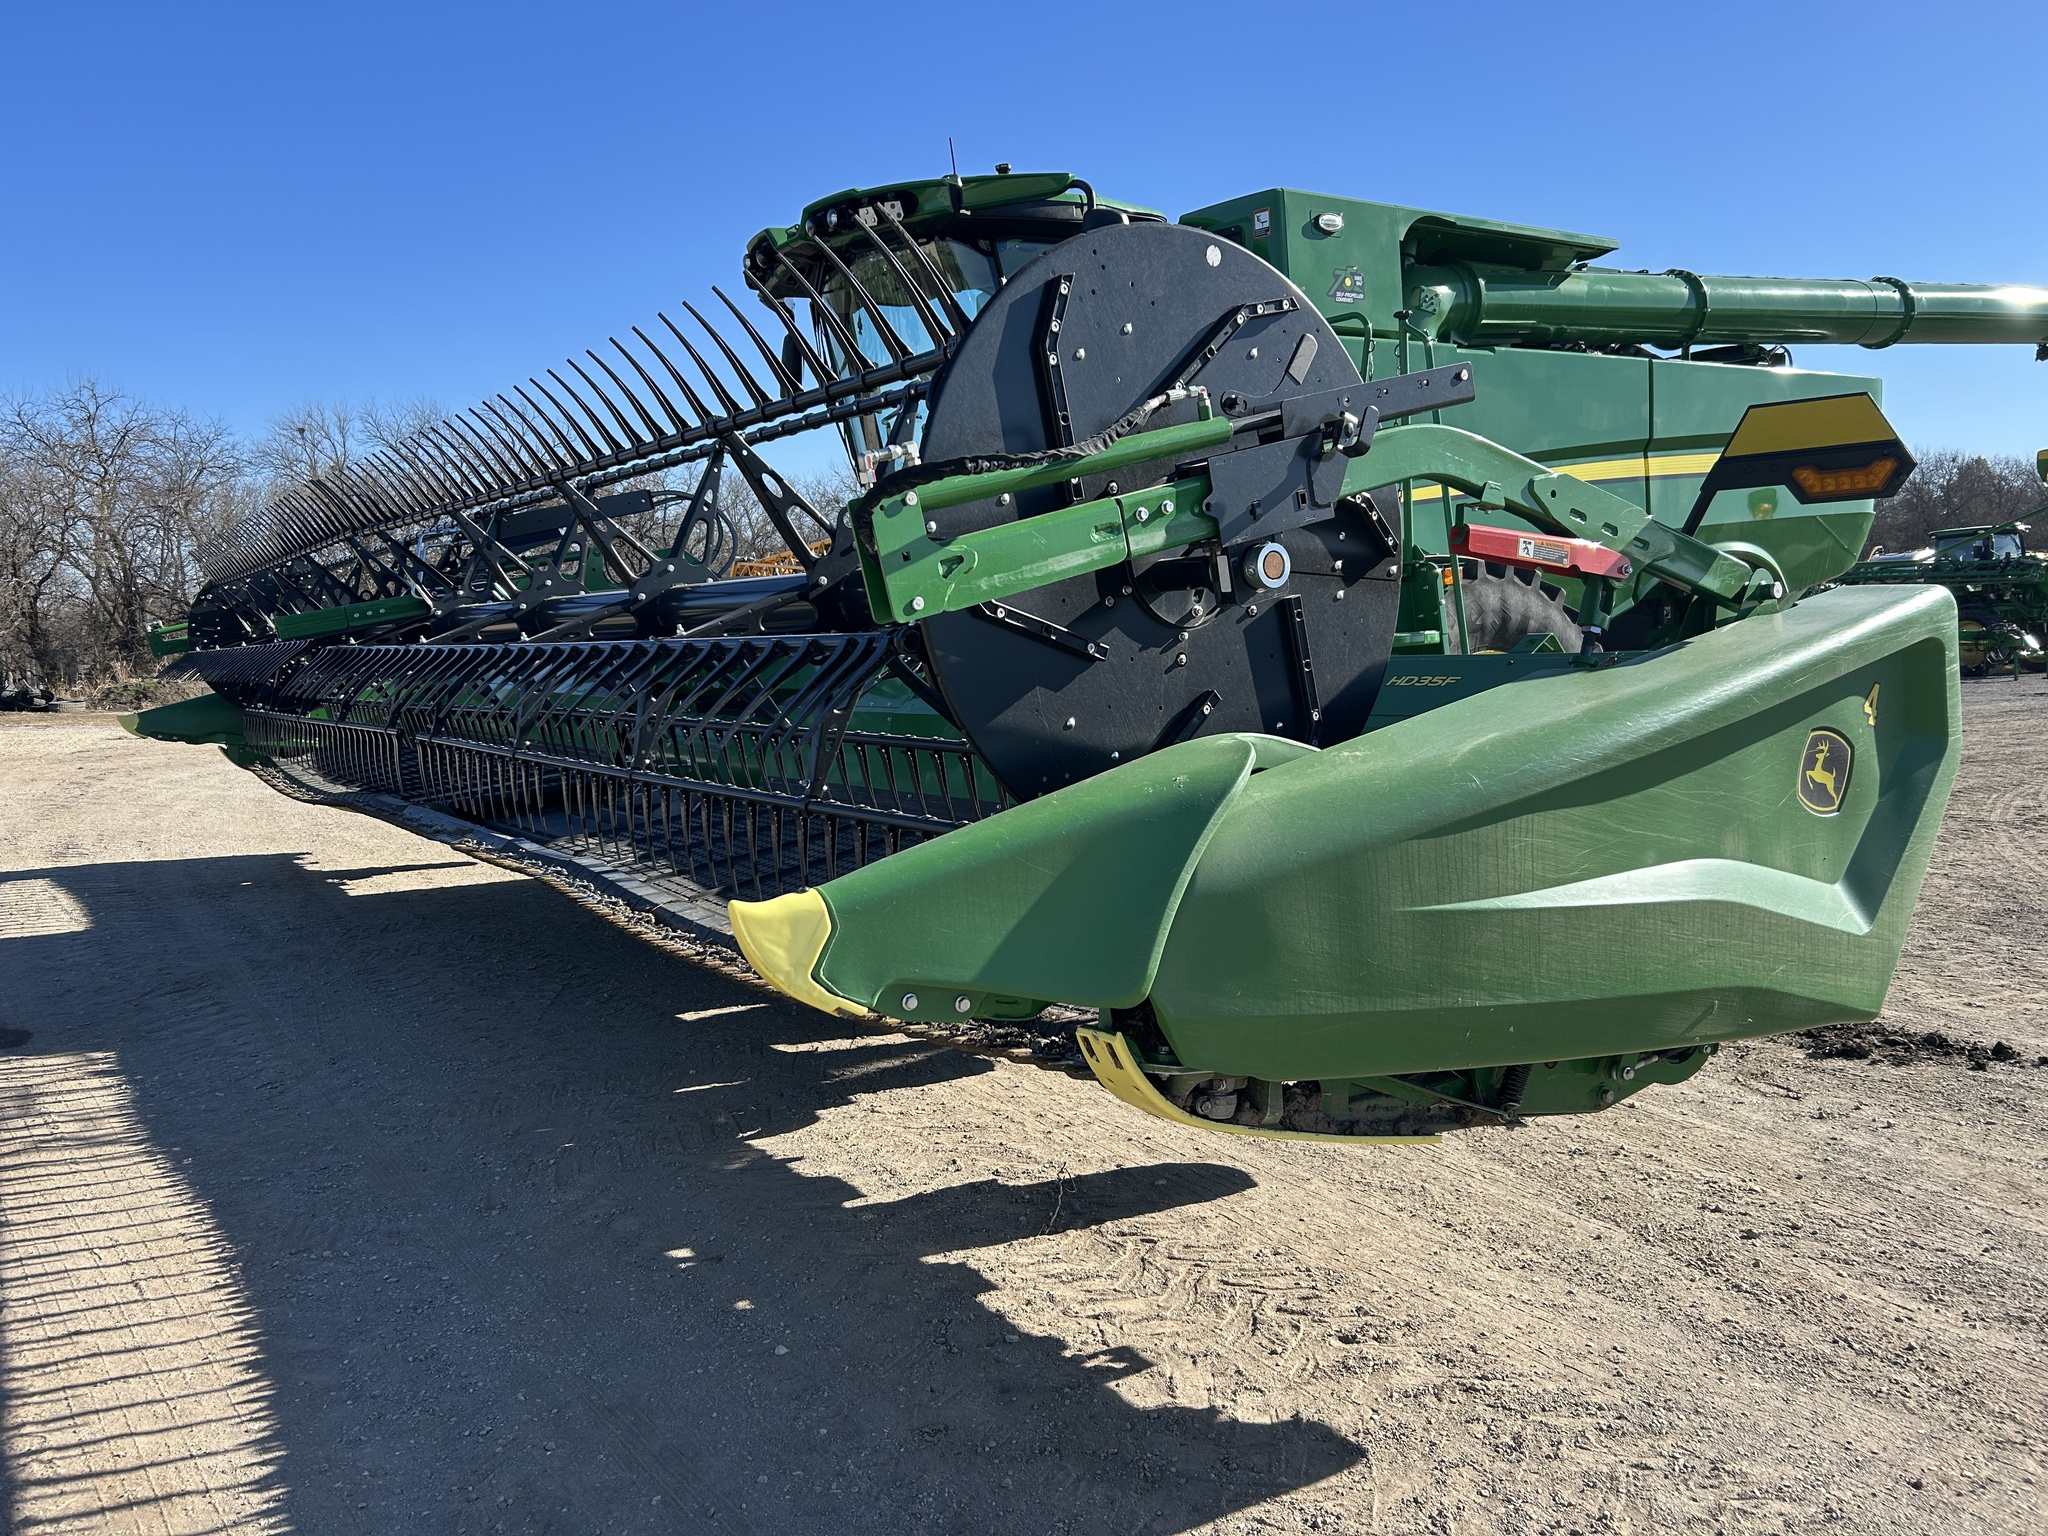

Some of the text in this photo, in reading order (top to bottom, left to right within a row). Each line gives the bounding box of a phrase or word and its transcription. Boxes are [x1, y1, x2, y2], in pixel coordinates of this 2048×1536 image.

[1376, 388, 1382, 399] 2
[1416, 379, 1423, 390] 3
[1545, 541, 1565, 550] WARNING
[1386, 675, 1462, 687] HD35F
[1863, 682, 1880, 727] 4
